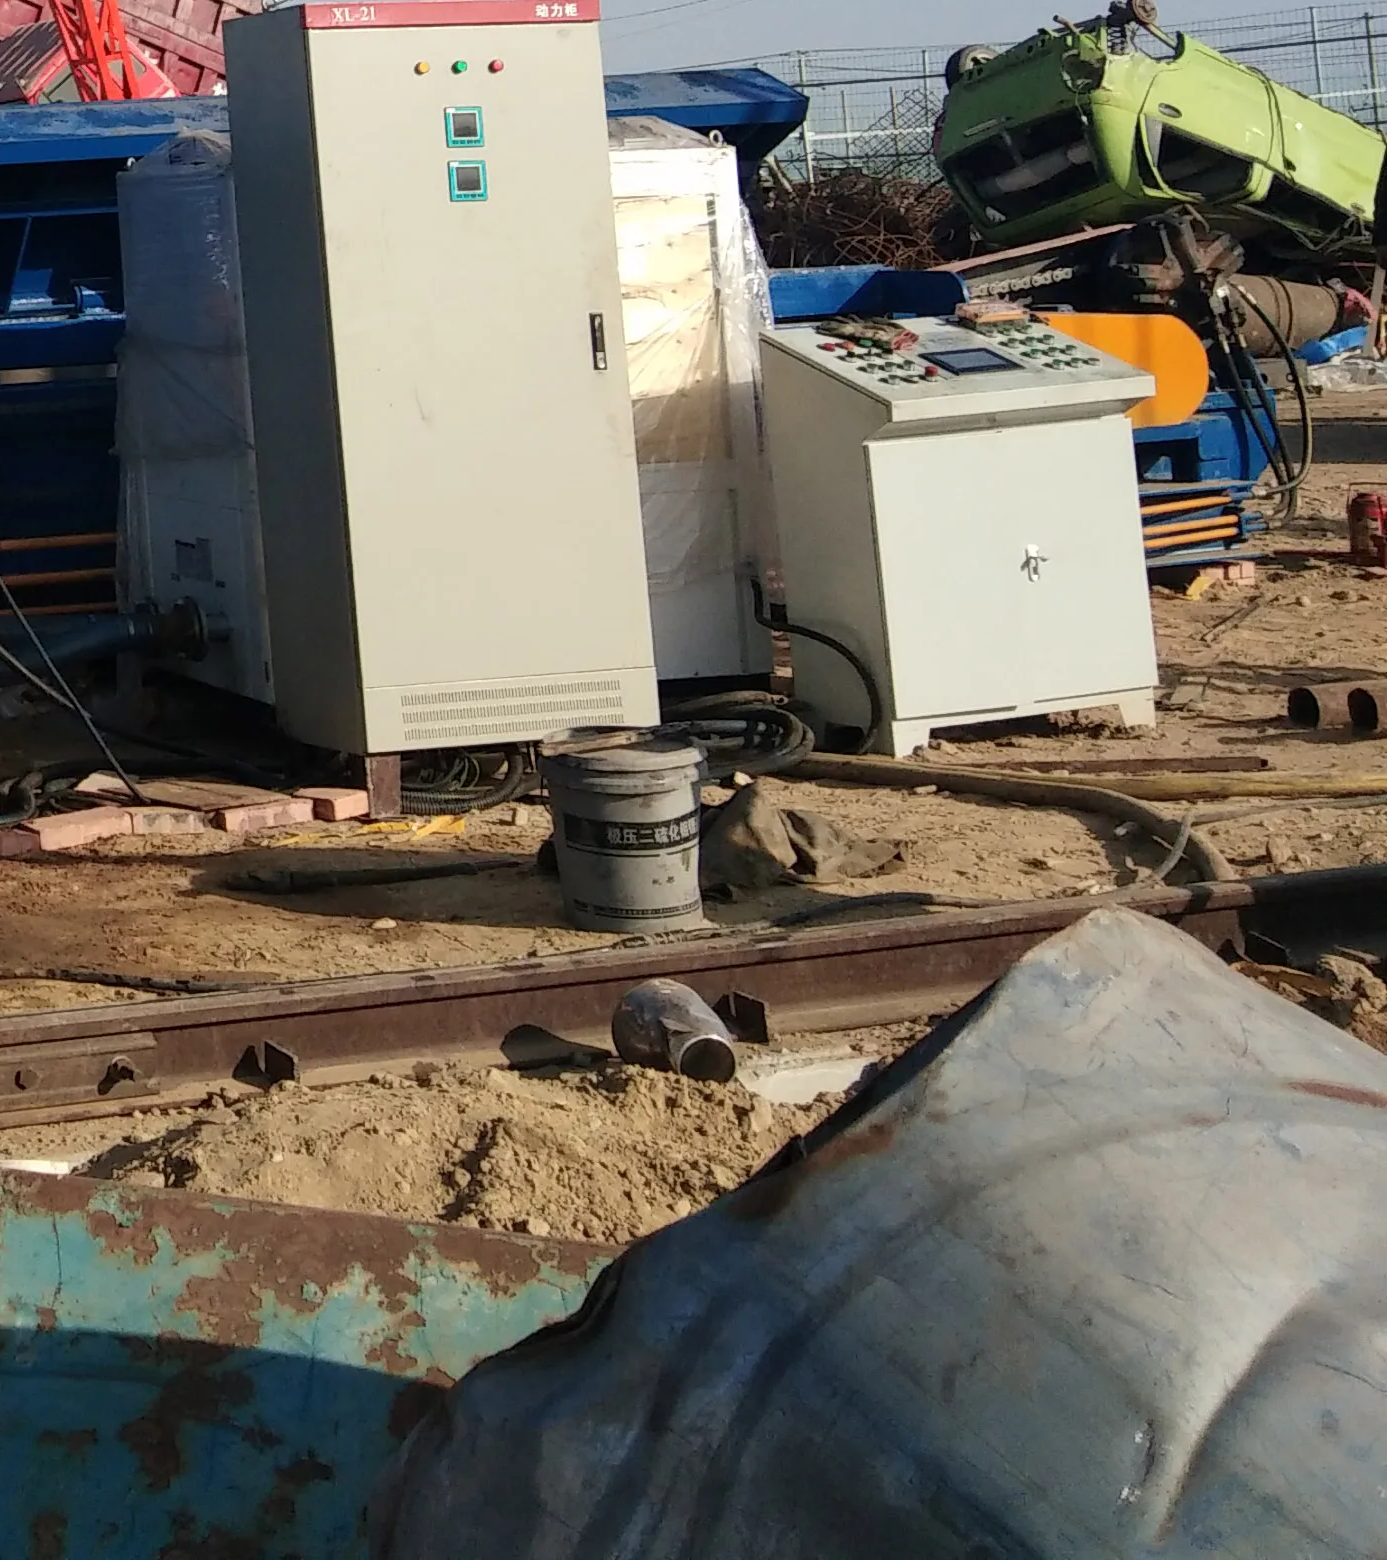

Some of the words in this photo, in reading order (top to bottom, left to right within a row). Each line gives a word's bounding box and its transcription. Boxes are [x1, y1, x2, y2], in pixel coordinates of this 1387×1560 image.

[331, 5, 376, 26] XL-21
[535, 3, 578, 18] 动力柜
